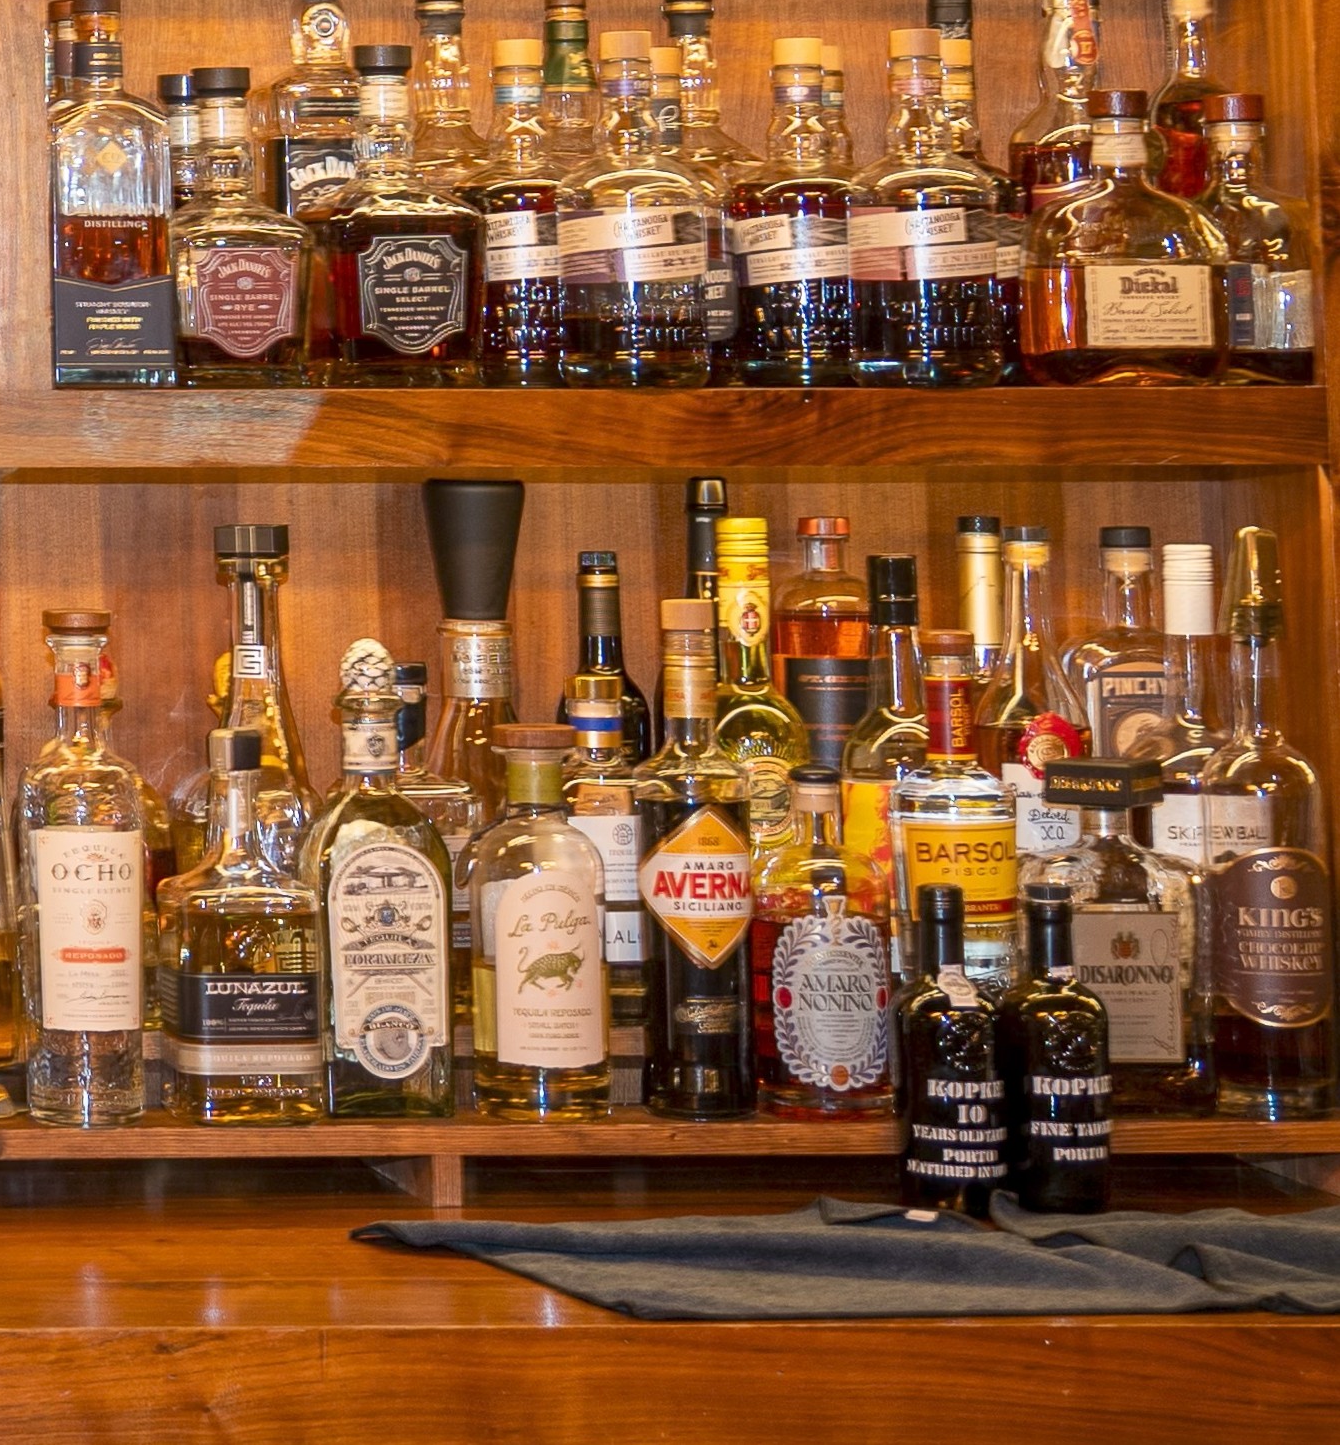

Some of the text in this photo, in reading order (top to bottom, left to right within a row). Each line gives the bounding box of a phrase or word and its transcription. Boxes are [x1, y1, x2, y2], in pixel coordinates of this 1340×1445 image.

[290, 163, 326, 190] JACK
[382, 247, 441, 268] JACK DANIEL'S
[217, 259, 272, 279] JACK DANIEL'S
[374, 286, 451, 295] SINGLE BARREL
[1119, 275, 1178, 295] Dickel
[209, 294, 242, 302] SINGLE
[233, 303, 255, 312] RYE
[951, 693, 965, 748] BARSOL
[915, 842, 1015, 863] BARSOL
[50, 860, 134, 884] OCHO
[683, 861, 735, 870] AMARO
[941, 867, 1000, 876] PISCO
[653, 871, 750, 900] AVERNA
[674, 902, 742, 912] SICILIANO
[508, 914, 532, 939] La
[1238, 907, 1324, 928] KING'S
[63, 949, 126, 962] REPOSADO
[1240, 954, 1324, 971] WHISKEY
[798, 974, 871, 993] AMARO
[1080, 965, 1174, 985] DISARONNO
[204, 980, 309, 997] LUNAZUL
[798, 993, 873, 1012] NONINO
[927, 1079, 1005, 1099] KOPKE
[1032, 1074, 1113, 1096] KOPKE
[957, 1104, 988, 1124] 10
[912, 1124, 985, 1142] YEARS OLD
[1030, 1121, 1073, 1137] FINE
[942, 1148, 998, 1163] PORTO
[1053, 1145, 1108, 1161] PORTO
[907, 1159, 976, 1178] MATURED
